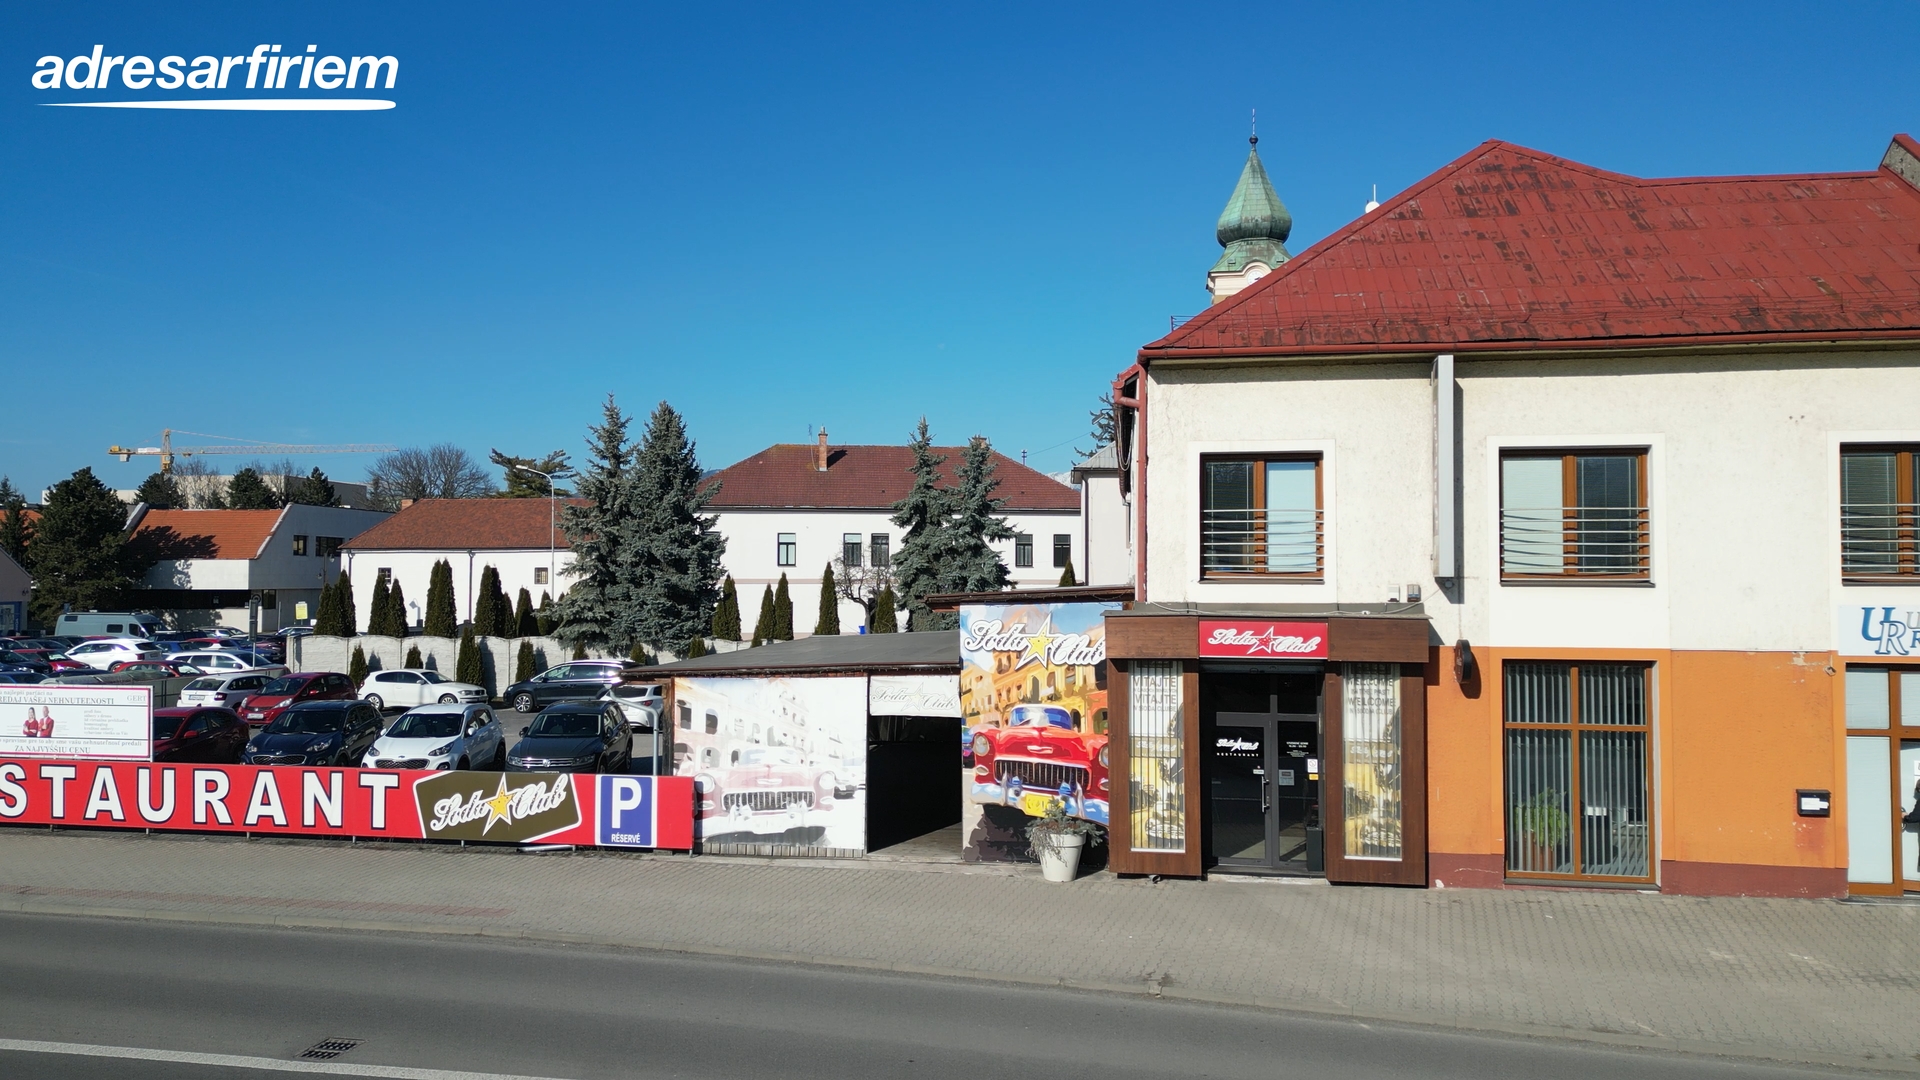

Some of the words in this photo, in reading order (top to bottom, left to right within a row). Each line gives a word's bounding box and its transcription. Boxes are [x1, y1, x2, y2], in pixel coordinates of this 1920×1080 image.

[965, 619, 1028, 651] Soda
[1208, 628, 1257, 645] Soda
[1273, 635, 1321, 653] Club
[872, 685, 907, 702] Soda
[921, 695, 957, 710] Club
[430, 789, 489, 831] Soda
[512, 773, 568, 819] Club
[611, 778, 642, 829] P
[611, 832, 641, 844] RÉSERVÉ
